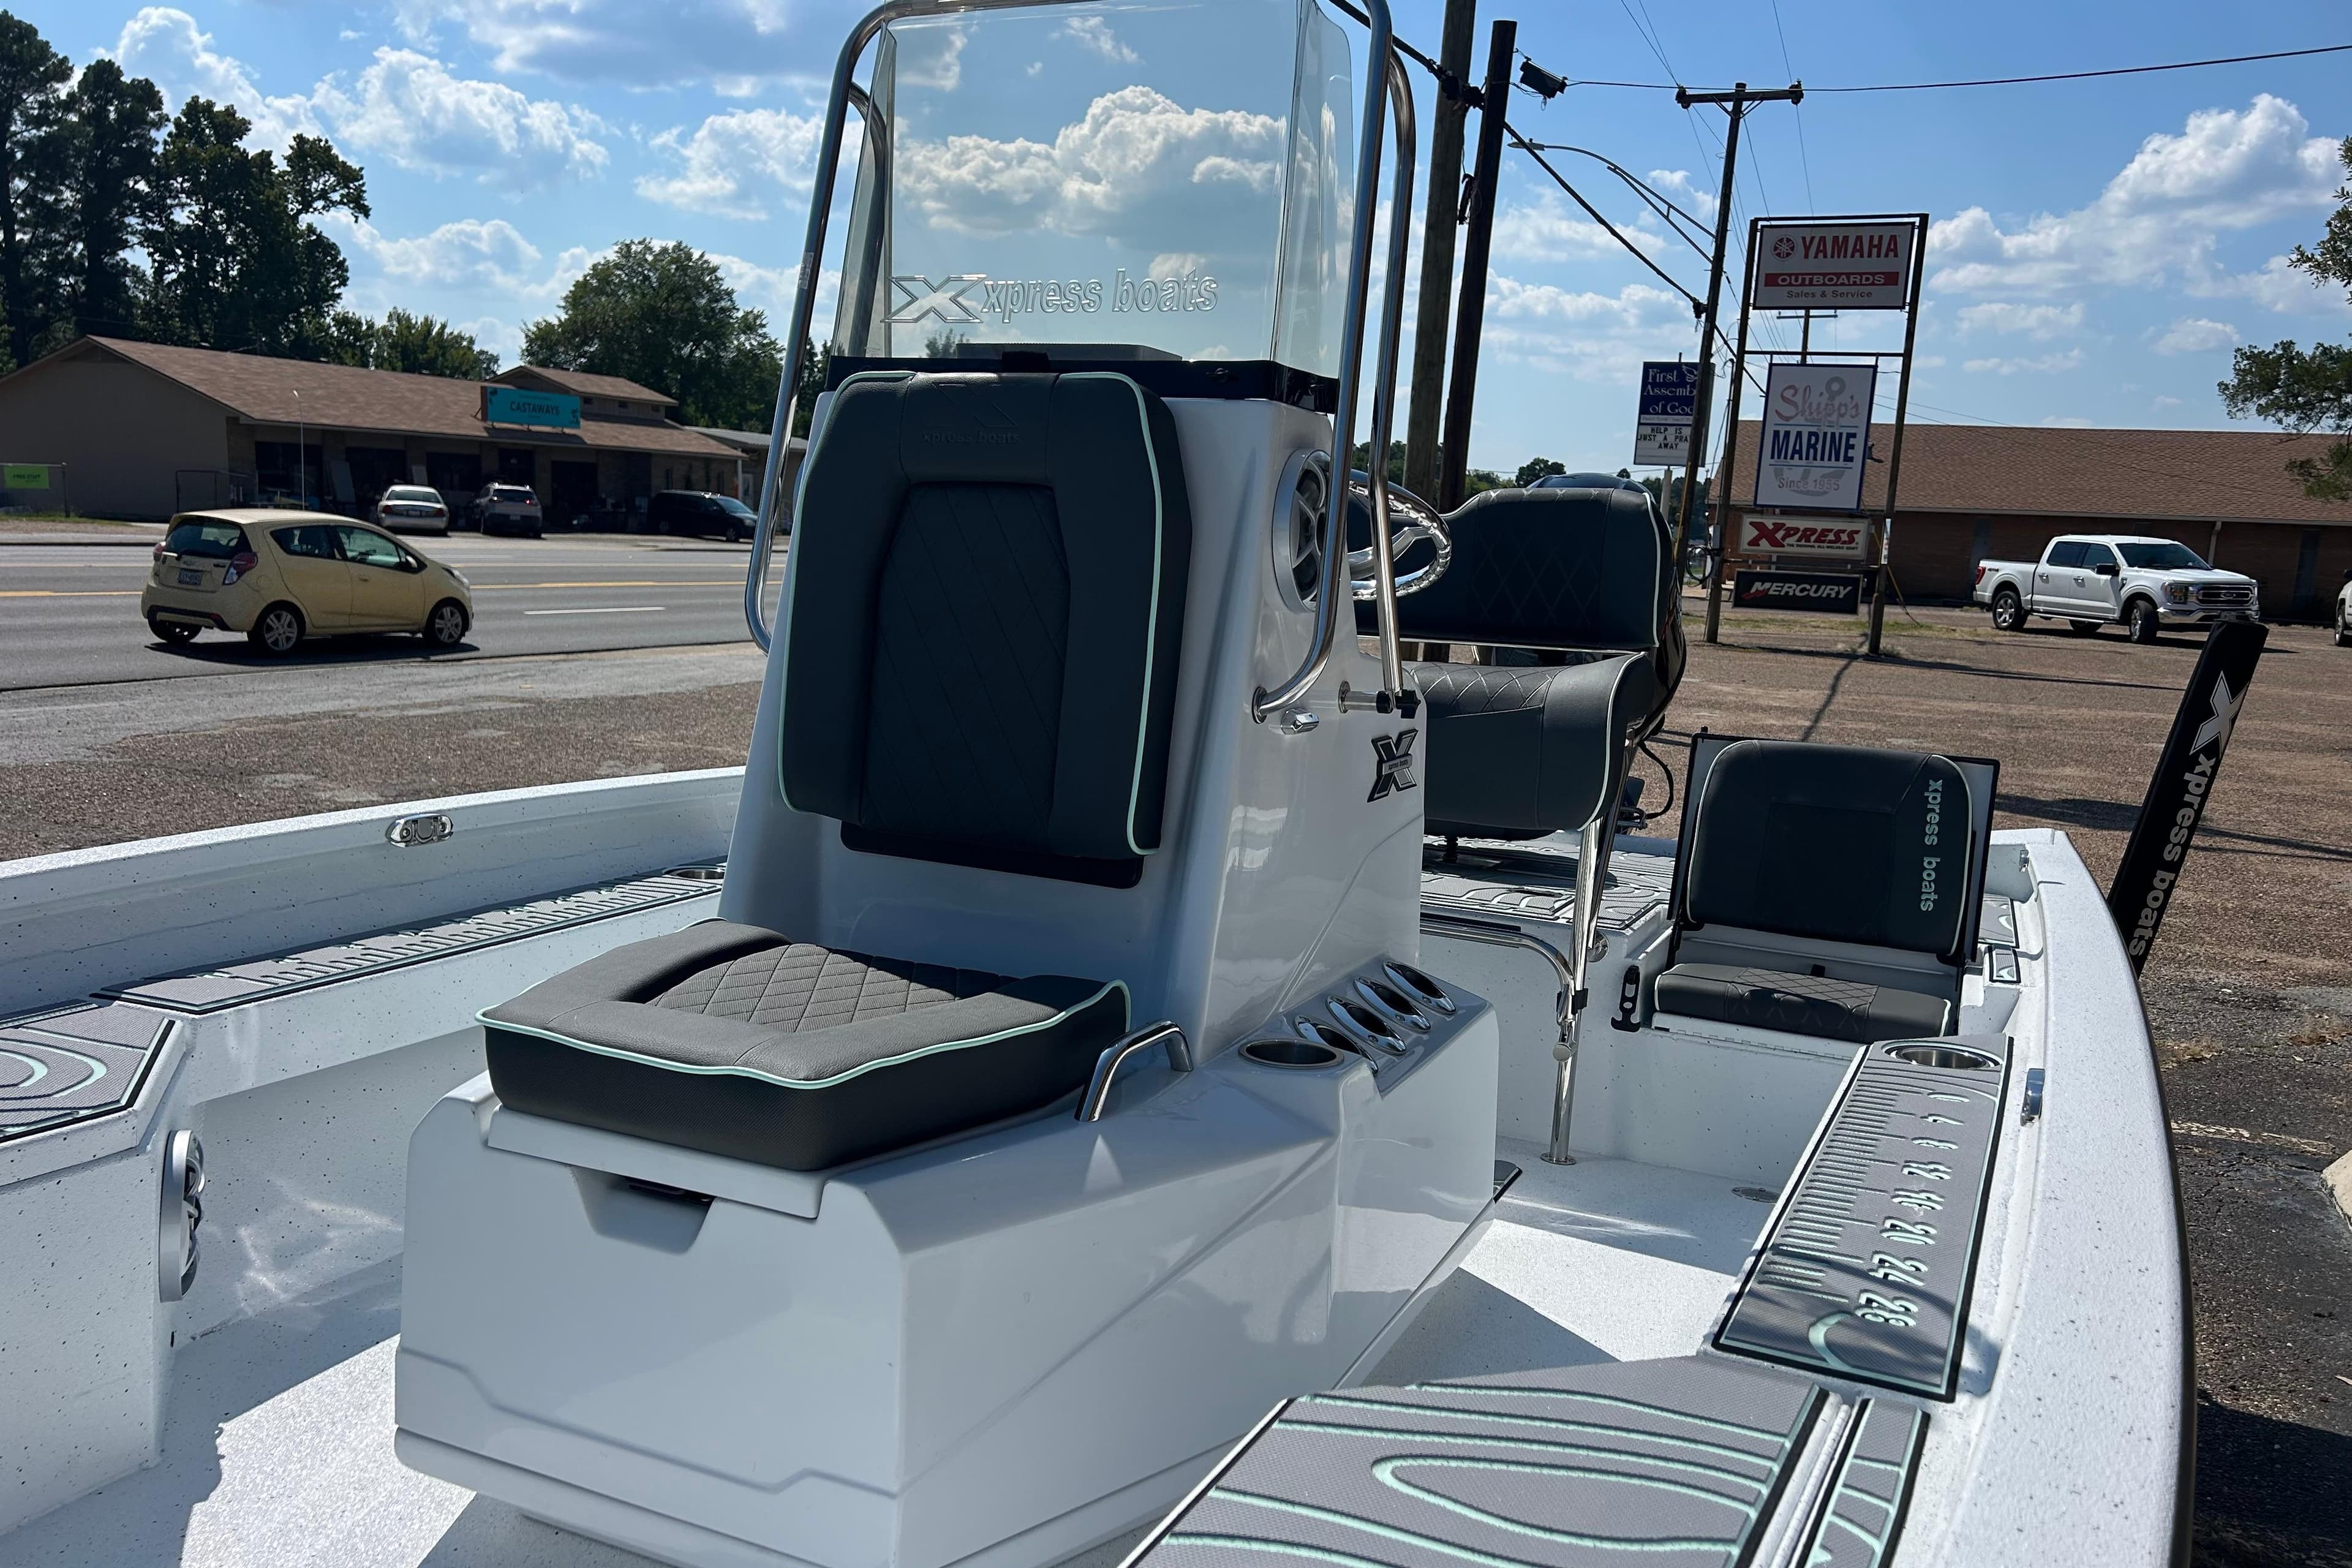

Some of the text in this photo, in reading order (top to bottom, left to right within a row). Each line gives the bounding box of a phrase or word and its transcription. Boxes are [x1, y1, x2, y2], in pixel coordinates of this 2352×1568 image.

[1801, 235, 1899, 259] YAMAHA
[1777, 274, 1885, 285] OUTBOARDS
[981, 279, 1103, 324] xpress
[1112, 266, 1219, 313] boats
[1786, 290, 1816, 299] Sales
[1831, 290, 1872, 299] Service
[1647, 369, 1680, 382] First
[1643, 384, 1697, 396] Assemb
[510, 401, 560, 416] CASTAWAYS
[1649, 401, 1665, 413] of
[1775, 385, 1860, 430] Shipp's
[1770, 430, 1857, 462] MARINE
[1777, 477, 1840, 491] Since 1955
[1747, 521, 1861, 548] XPRESS
[1750, 581, 1853, 598] MERCURY
[2163, 753, 2216, 861] xpress
[1920, 778, 1943, 911] xpress boats
[2129, 869, 2177, 956] boats
[1881, 1218, 1938, 1245] 20
[1868, 1253, 1929, 1286] 24
[1854, 1291, 1917, 1327] 28
